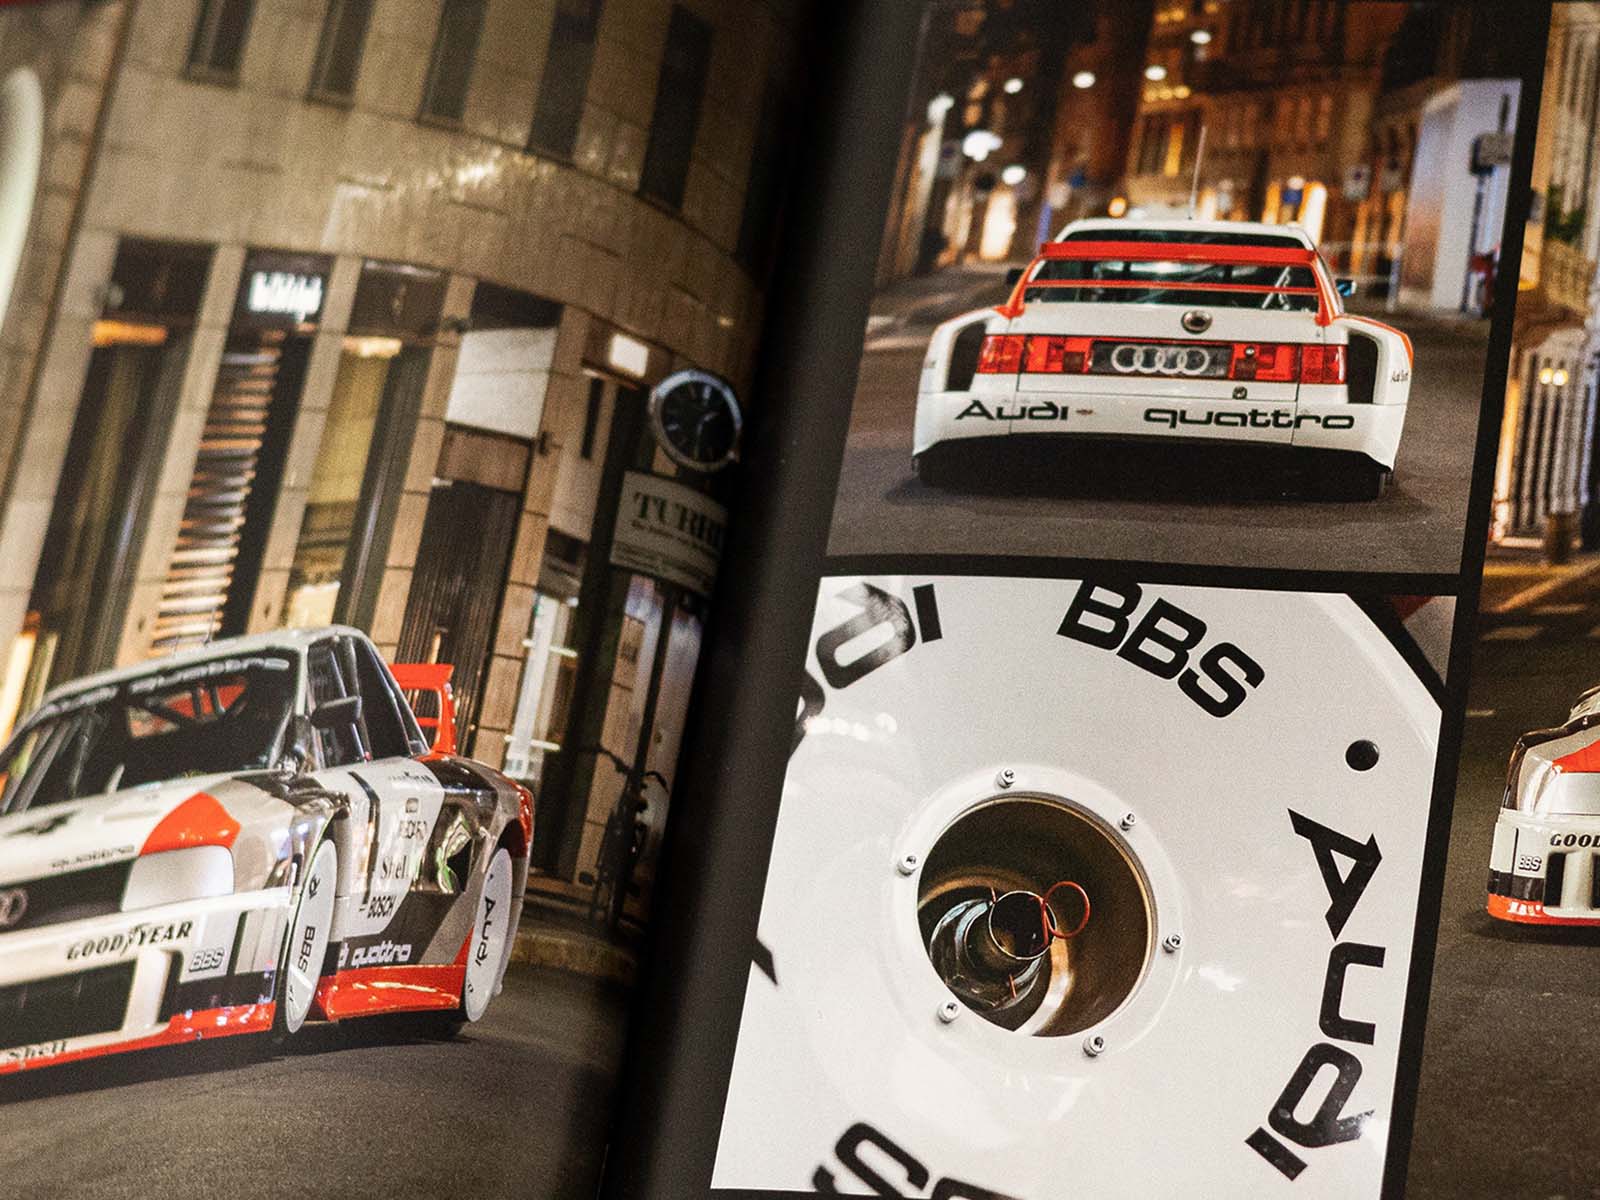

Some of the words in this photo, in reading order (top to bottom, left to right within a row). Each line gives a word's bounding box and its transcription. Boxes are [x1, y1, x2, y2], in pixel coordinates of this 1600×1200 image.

[955, 399, 1069, 421] Audi
[1143, 407, 1355, 429] quattro
[1057, 579, 1266, 719] BBS
[188, 947, 225, 972] BBS
[298, 926, 316, 973] BBS
[351, 940, 412, 969] quattro
[1245, 808, 1386, 1182] Audi
